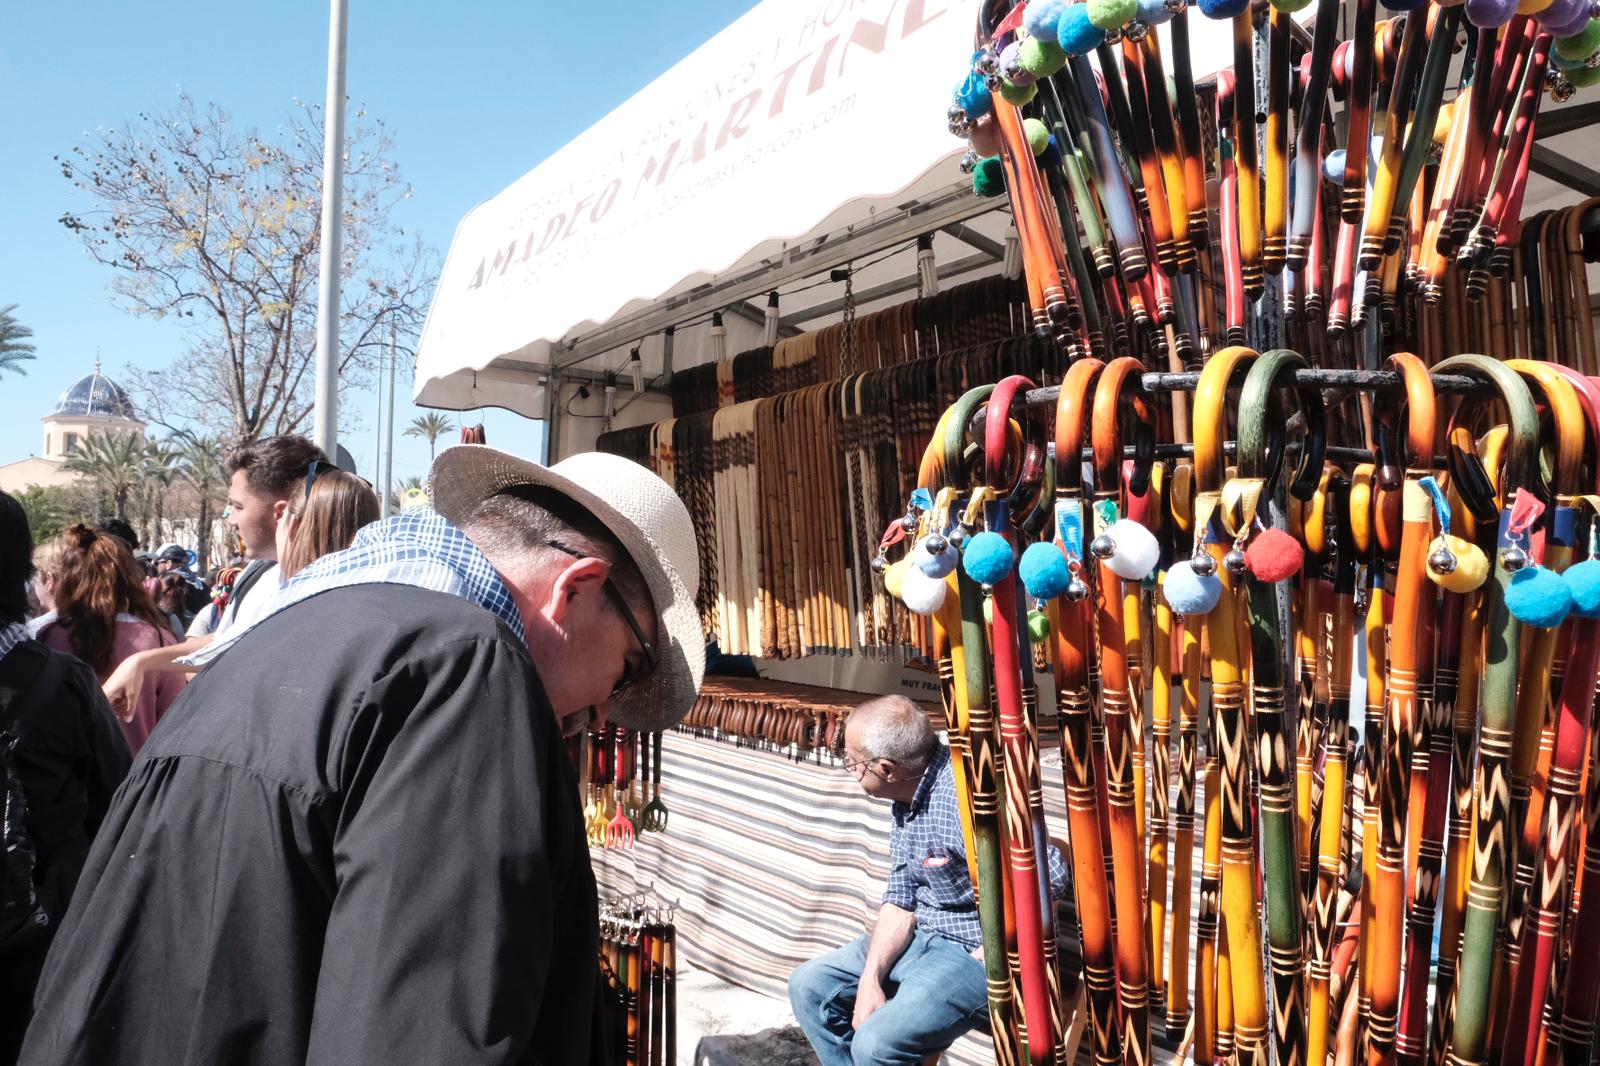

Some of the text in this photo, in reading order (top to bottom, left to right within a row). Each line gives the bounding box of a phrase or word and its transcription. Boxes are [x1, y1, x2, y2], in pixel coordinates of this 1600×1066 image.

[799, 0, 866, 46] HO
[466, 177, 623, 292] AMADEO
[901, 679, 920, 689] MUY
